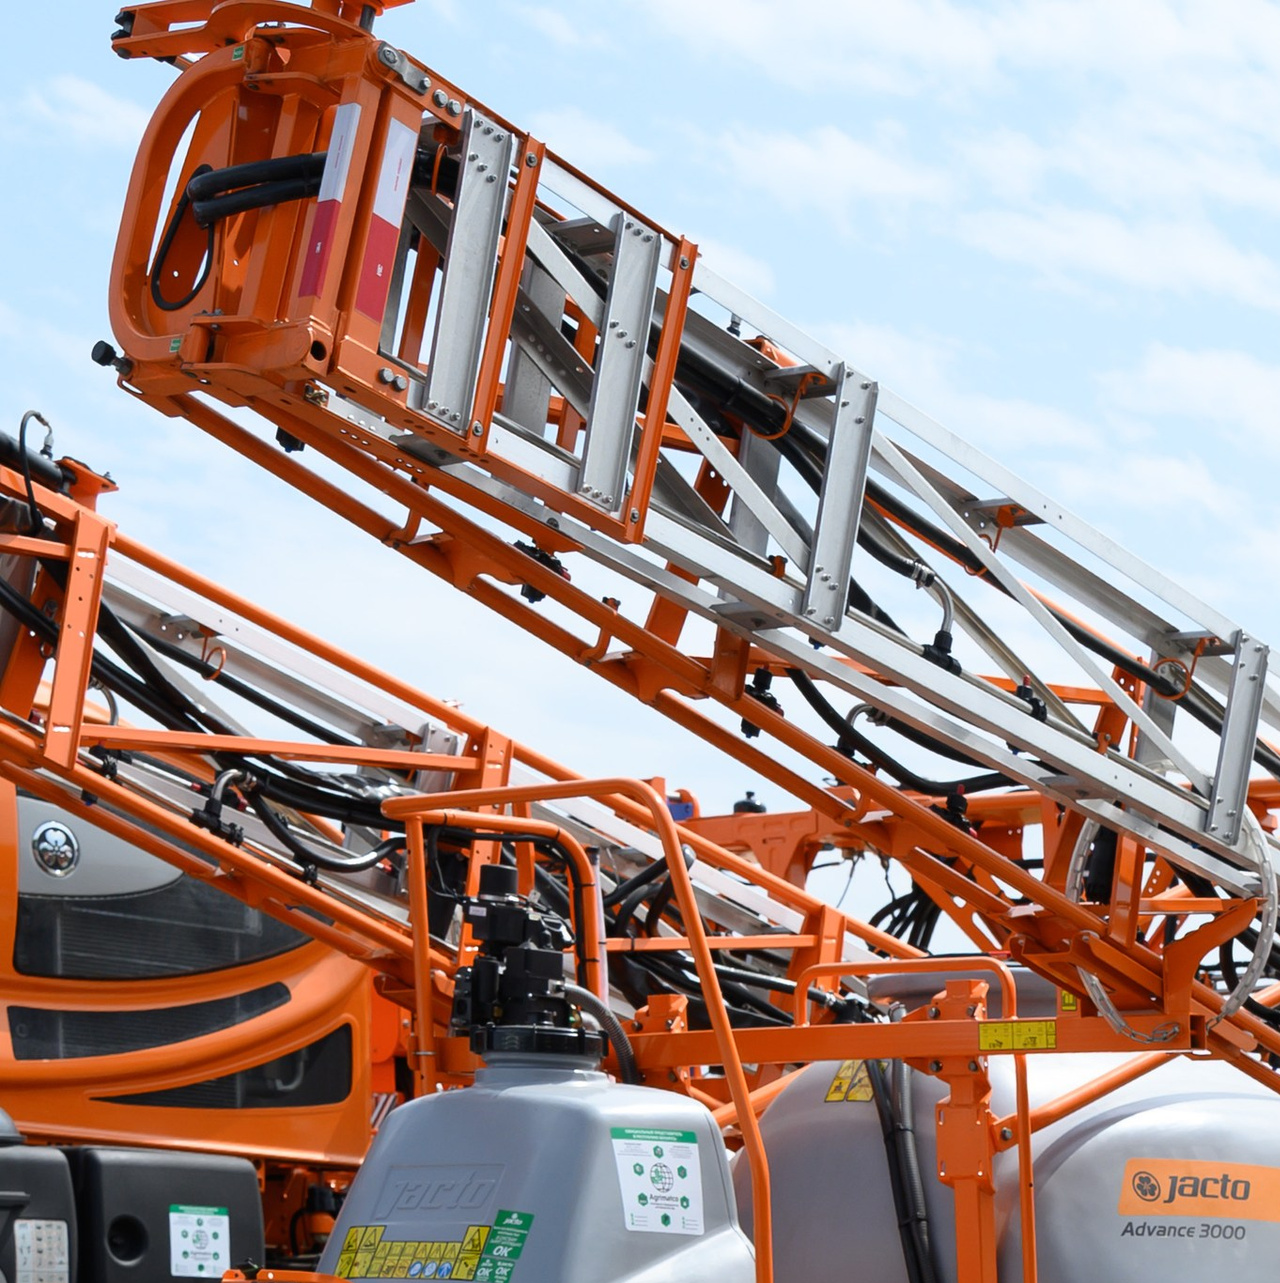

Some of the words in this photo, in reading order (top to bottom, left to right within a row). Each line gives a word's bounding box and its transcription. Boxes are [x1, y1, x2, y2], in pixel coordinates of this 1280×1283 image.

[1163, 1174, 1251, 1203] jacto
[1121, 1221, 1196, 1239] Advance
[1199, 1223, 1246, 1240] 3000
[493, 1245, 513, 1257] OK
